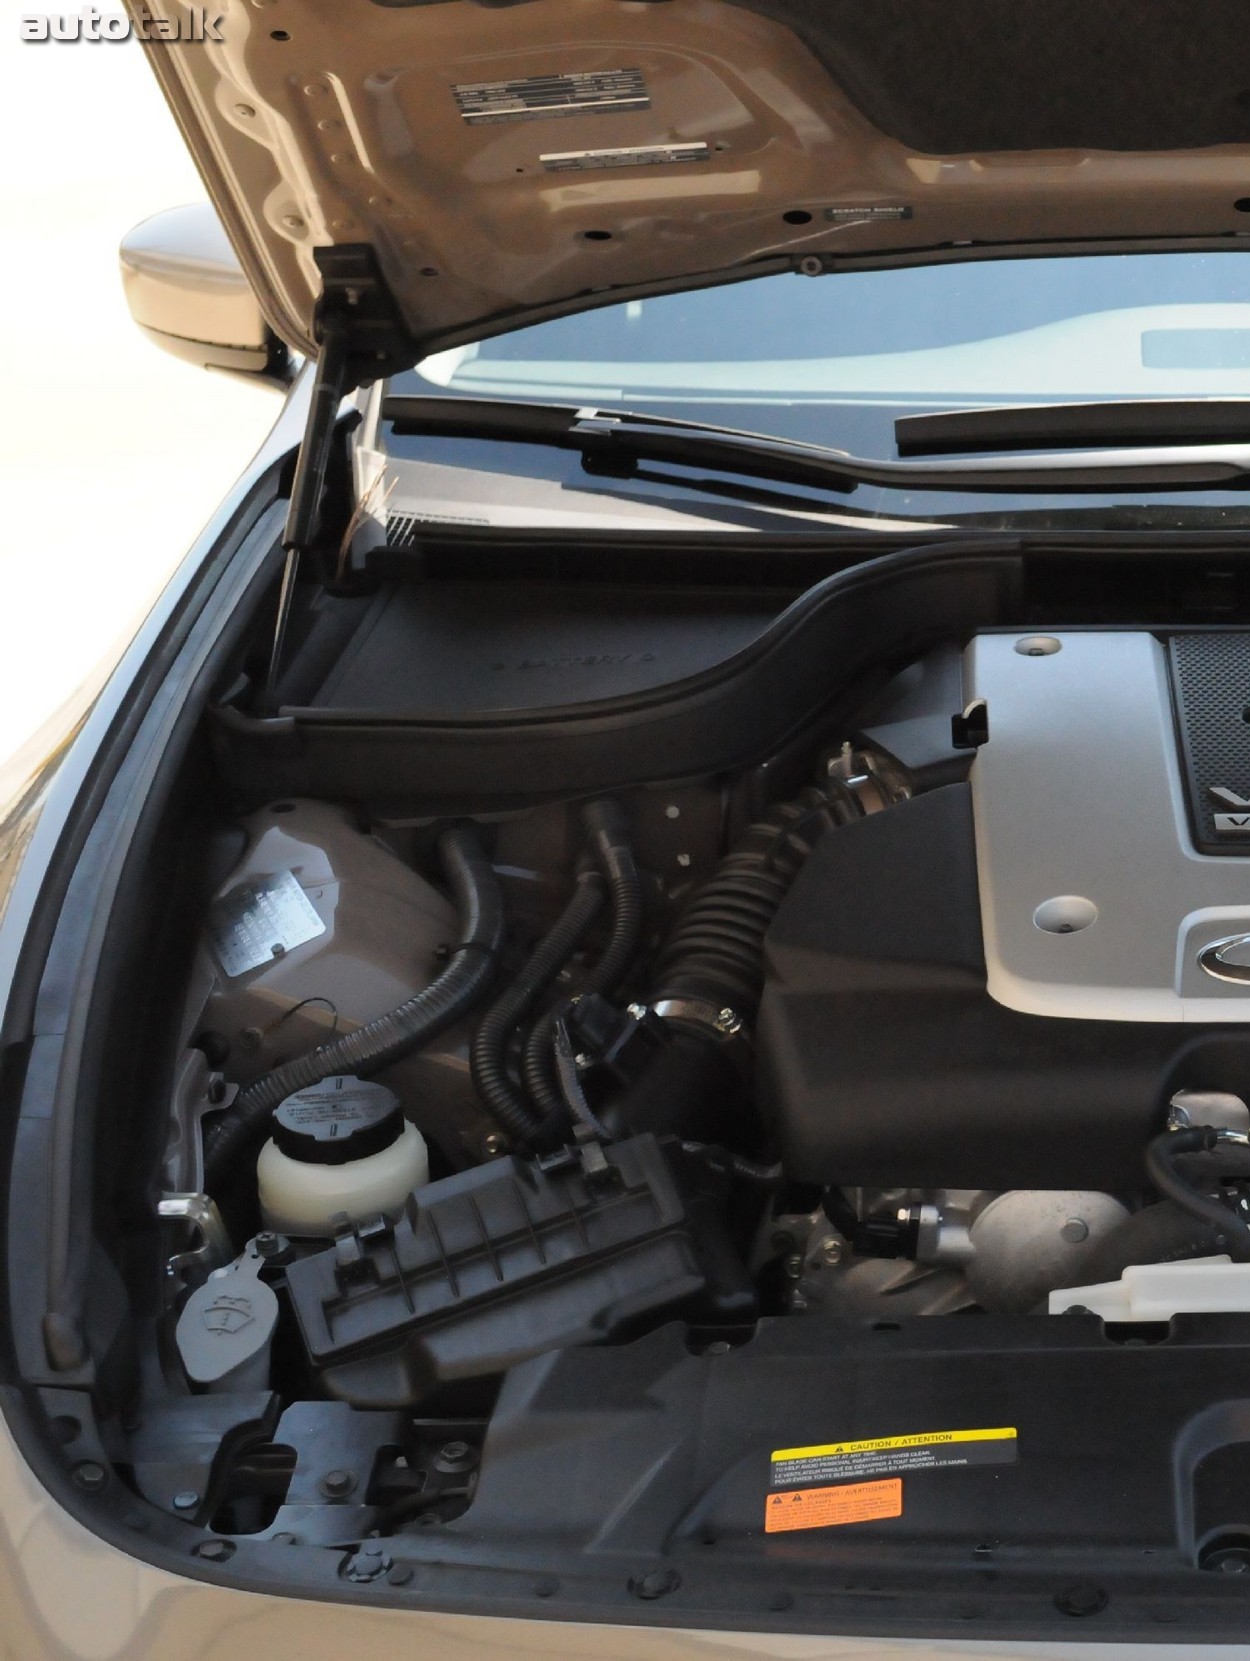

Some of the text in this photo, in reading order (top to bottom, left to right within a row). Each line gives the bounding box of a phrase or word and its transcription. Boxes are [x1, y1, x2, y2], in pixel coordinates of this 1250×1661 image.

[850, 1440, 892, 1451] CAUTION
[901, 1434, 953, 1445] ATTENTION
[820, 1460, 850, 1468] PERSONAL
[783, 1469, 820, 1478] VENTILATEUR
